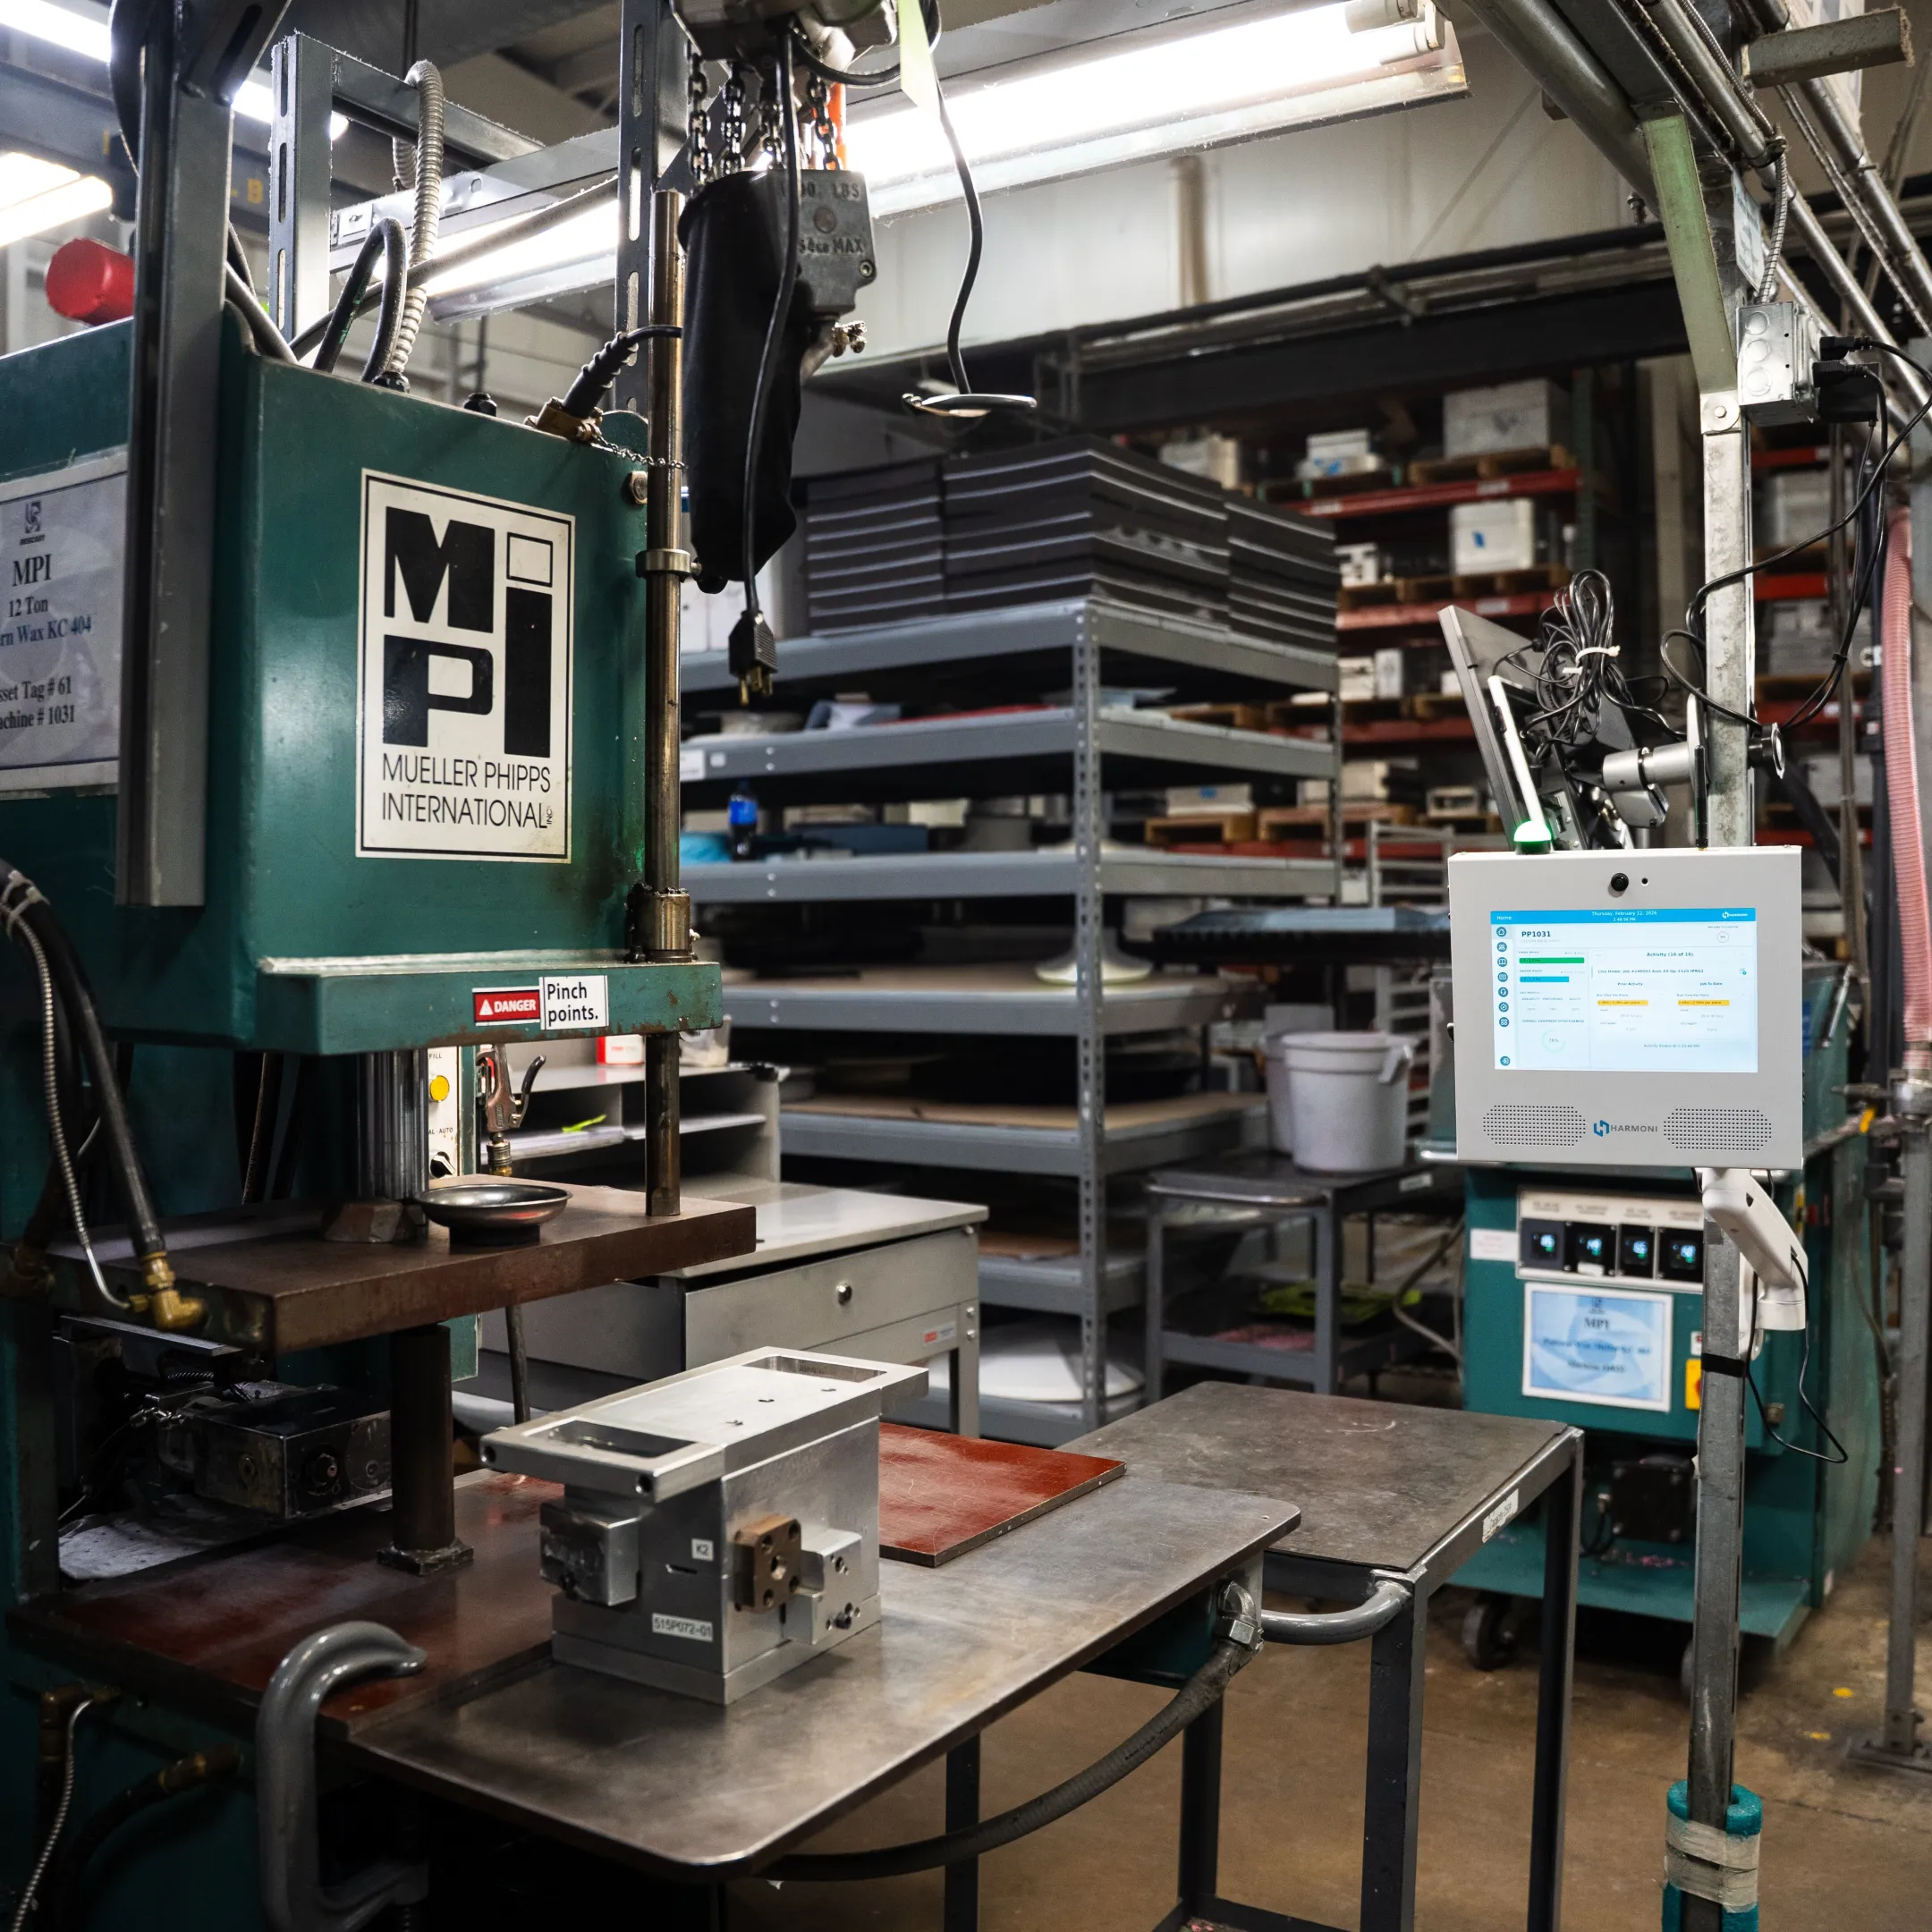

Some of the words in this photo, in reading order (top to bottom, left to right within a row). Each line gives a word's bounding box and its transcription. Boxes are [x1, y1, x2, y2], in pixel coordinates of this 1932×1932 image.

[831, 182, 860, 199] LBS
[832, 237, 864, 254] MAX
[13, 554, 53, 587] MPI
[9, 598, 22, 617] 12
[25, 596, 48, 614] Ton
[17, 624, 44, 643] Wax
[47, 618, 69, 640] KC
[71, 614, 92, 636] 404
[0, 685, 19, 702] sset
[21, 681, 45, 702] Tag
[47, 678, 55, 696] #
[57, 676, 72, 695] 61
[37, 708, 45, 725] #
[48, 705, 75, 724] 1031
[382, 752, 478, 788] MUELLER
[484, 761, 551, 793] PHIPPS
[382, 792, 547, 829] INTERNATIONAL
[547, 981, 587, 1000] Pinch
[494, 999, 537, 1013] DANGER
[547, 1004, 599, 1027] points.
[1610, 1124, 1658, 1132] HARMONI
